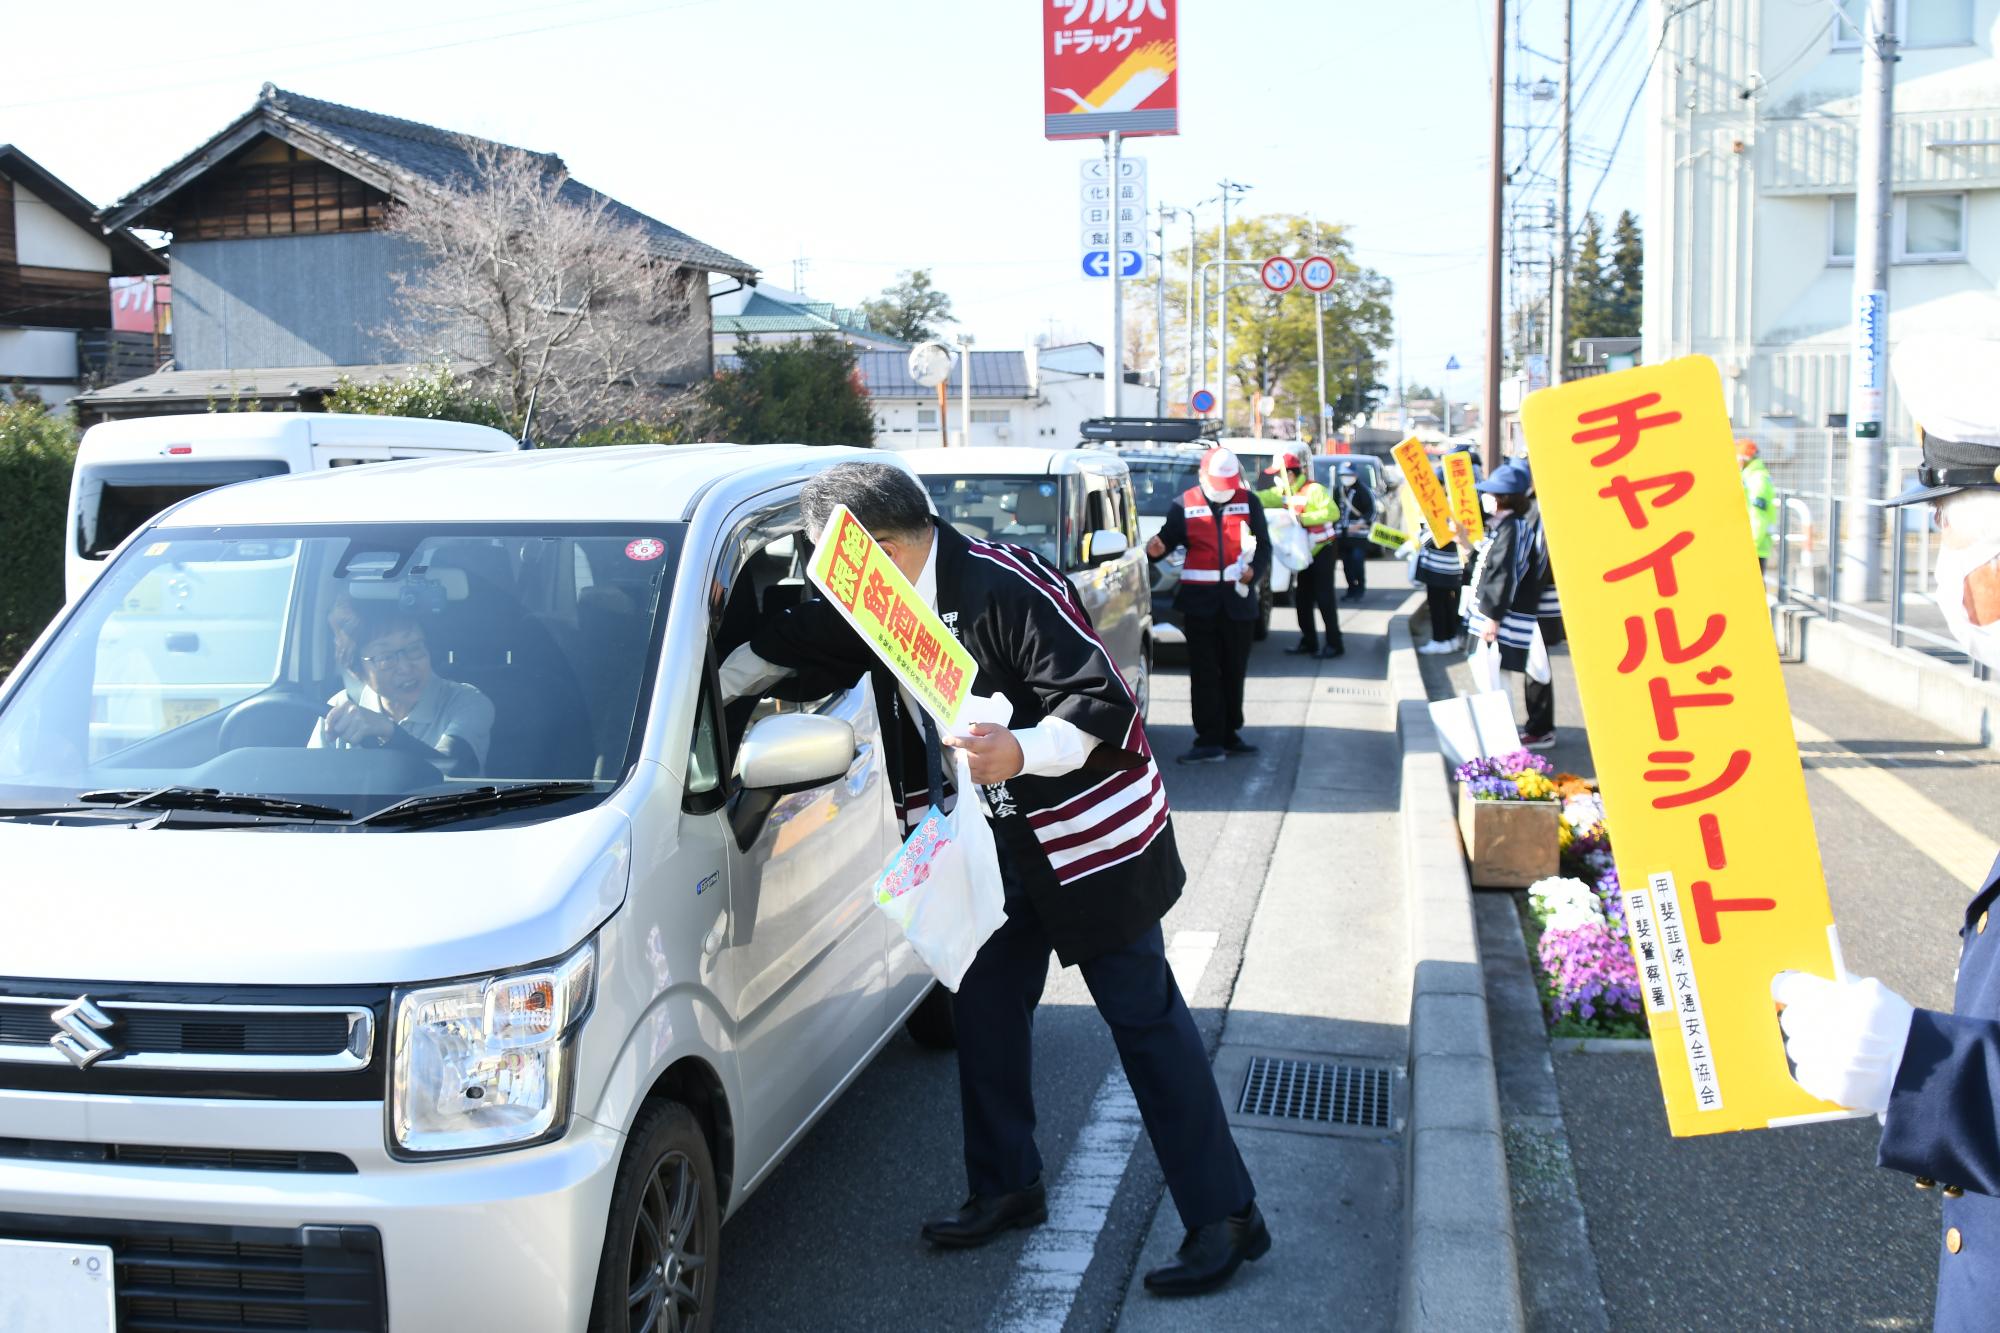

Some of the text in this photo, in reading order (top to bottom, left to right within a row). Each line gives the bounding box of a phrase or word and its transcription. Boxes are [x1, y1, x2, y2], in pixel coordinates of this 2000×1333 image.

[1054, 26, 1142, 56] ドラッグ
[1091, 162, 1134, 177] くり
[1091, 185, 1134, 200] 化品
[1091, 208, 1134, 223] 日品
[1309, 265, 1329, 281] 40
[829, 521, 870, 606] 根絶
[863, 568, 964, 706] 飲酒運転
[1572, 392, 1777, 945] チャイルドシート
[1631, 895, 1666, 1007] 甲斐警察署
